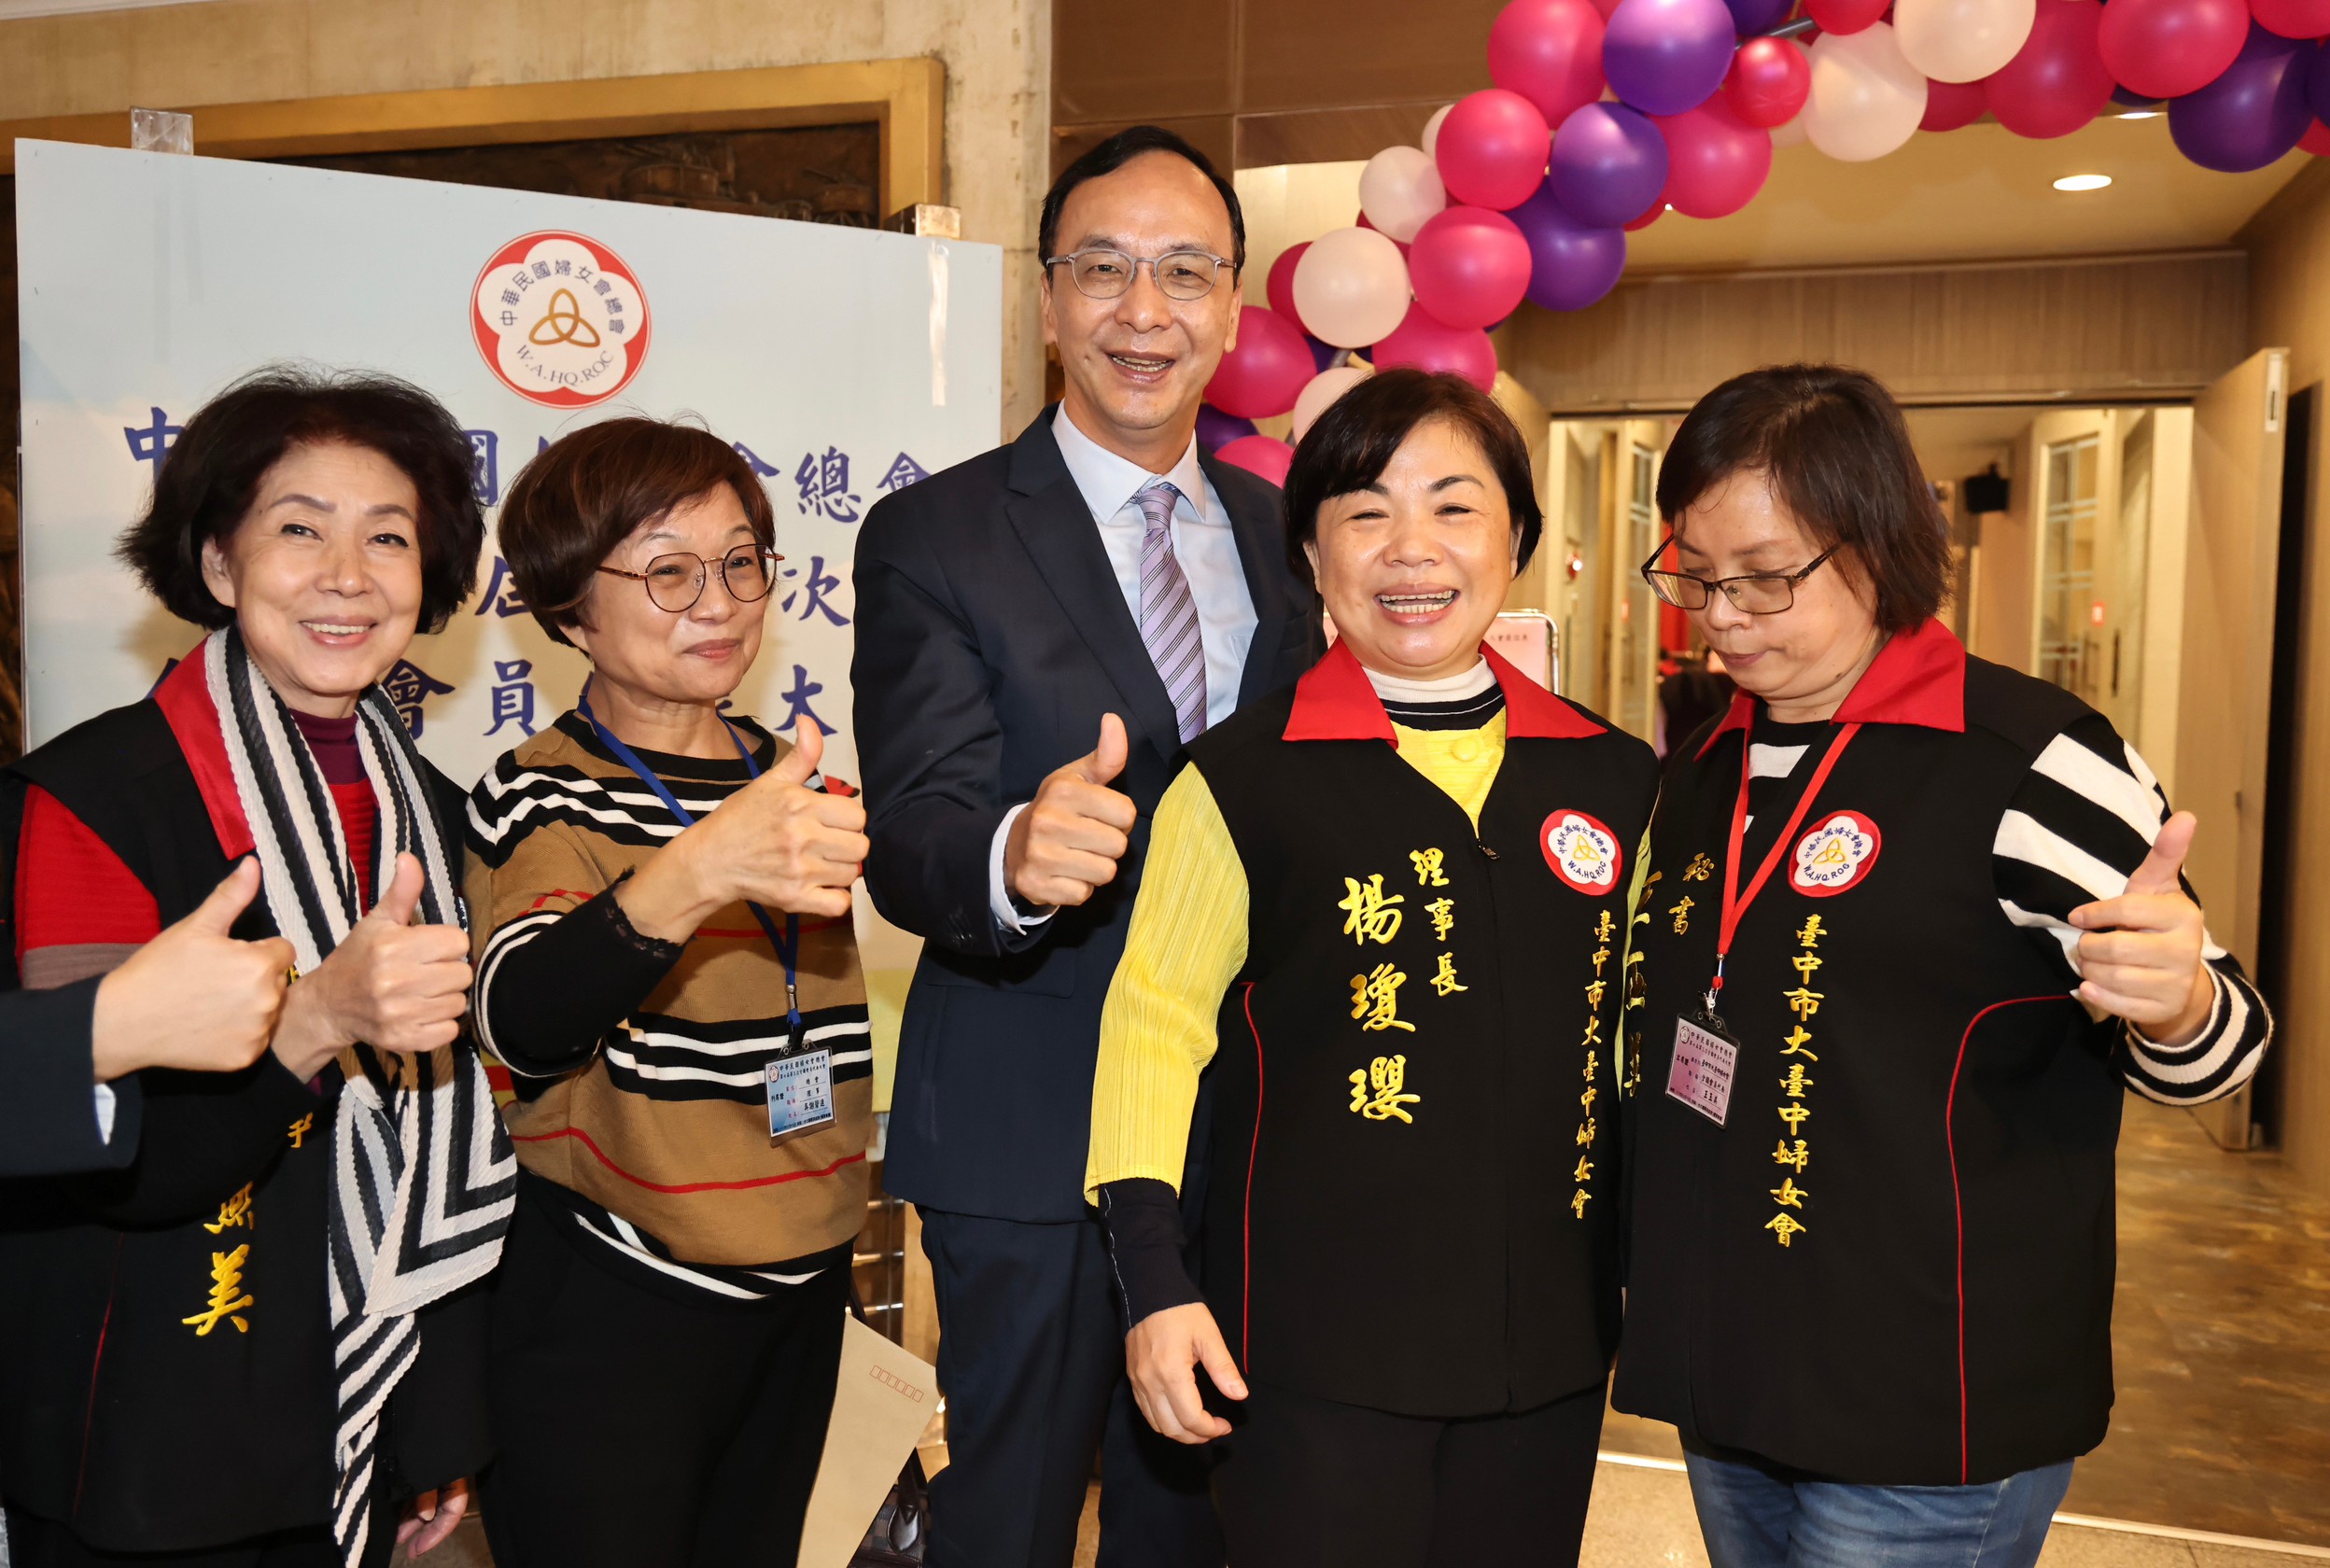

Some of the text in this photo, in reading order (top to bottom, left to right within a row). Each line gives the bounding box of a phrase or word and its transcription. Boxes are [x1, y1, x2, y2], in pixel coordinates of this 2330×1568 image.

[499, 259, 625, 335] 中華民國婦女會總會
[781, 555, 851, 627] 次
[774, 664, 838, 736] 大
[1410, 847, 1468, 996] 理事長
[1338, 874, 1421, 1124] 楊瓊瓔
[1571, 909, 1616, 1219] 臺中市大臺中婦女會
[1764, 913, 1828, 1247] 臺中市大臺中婦女會
